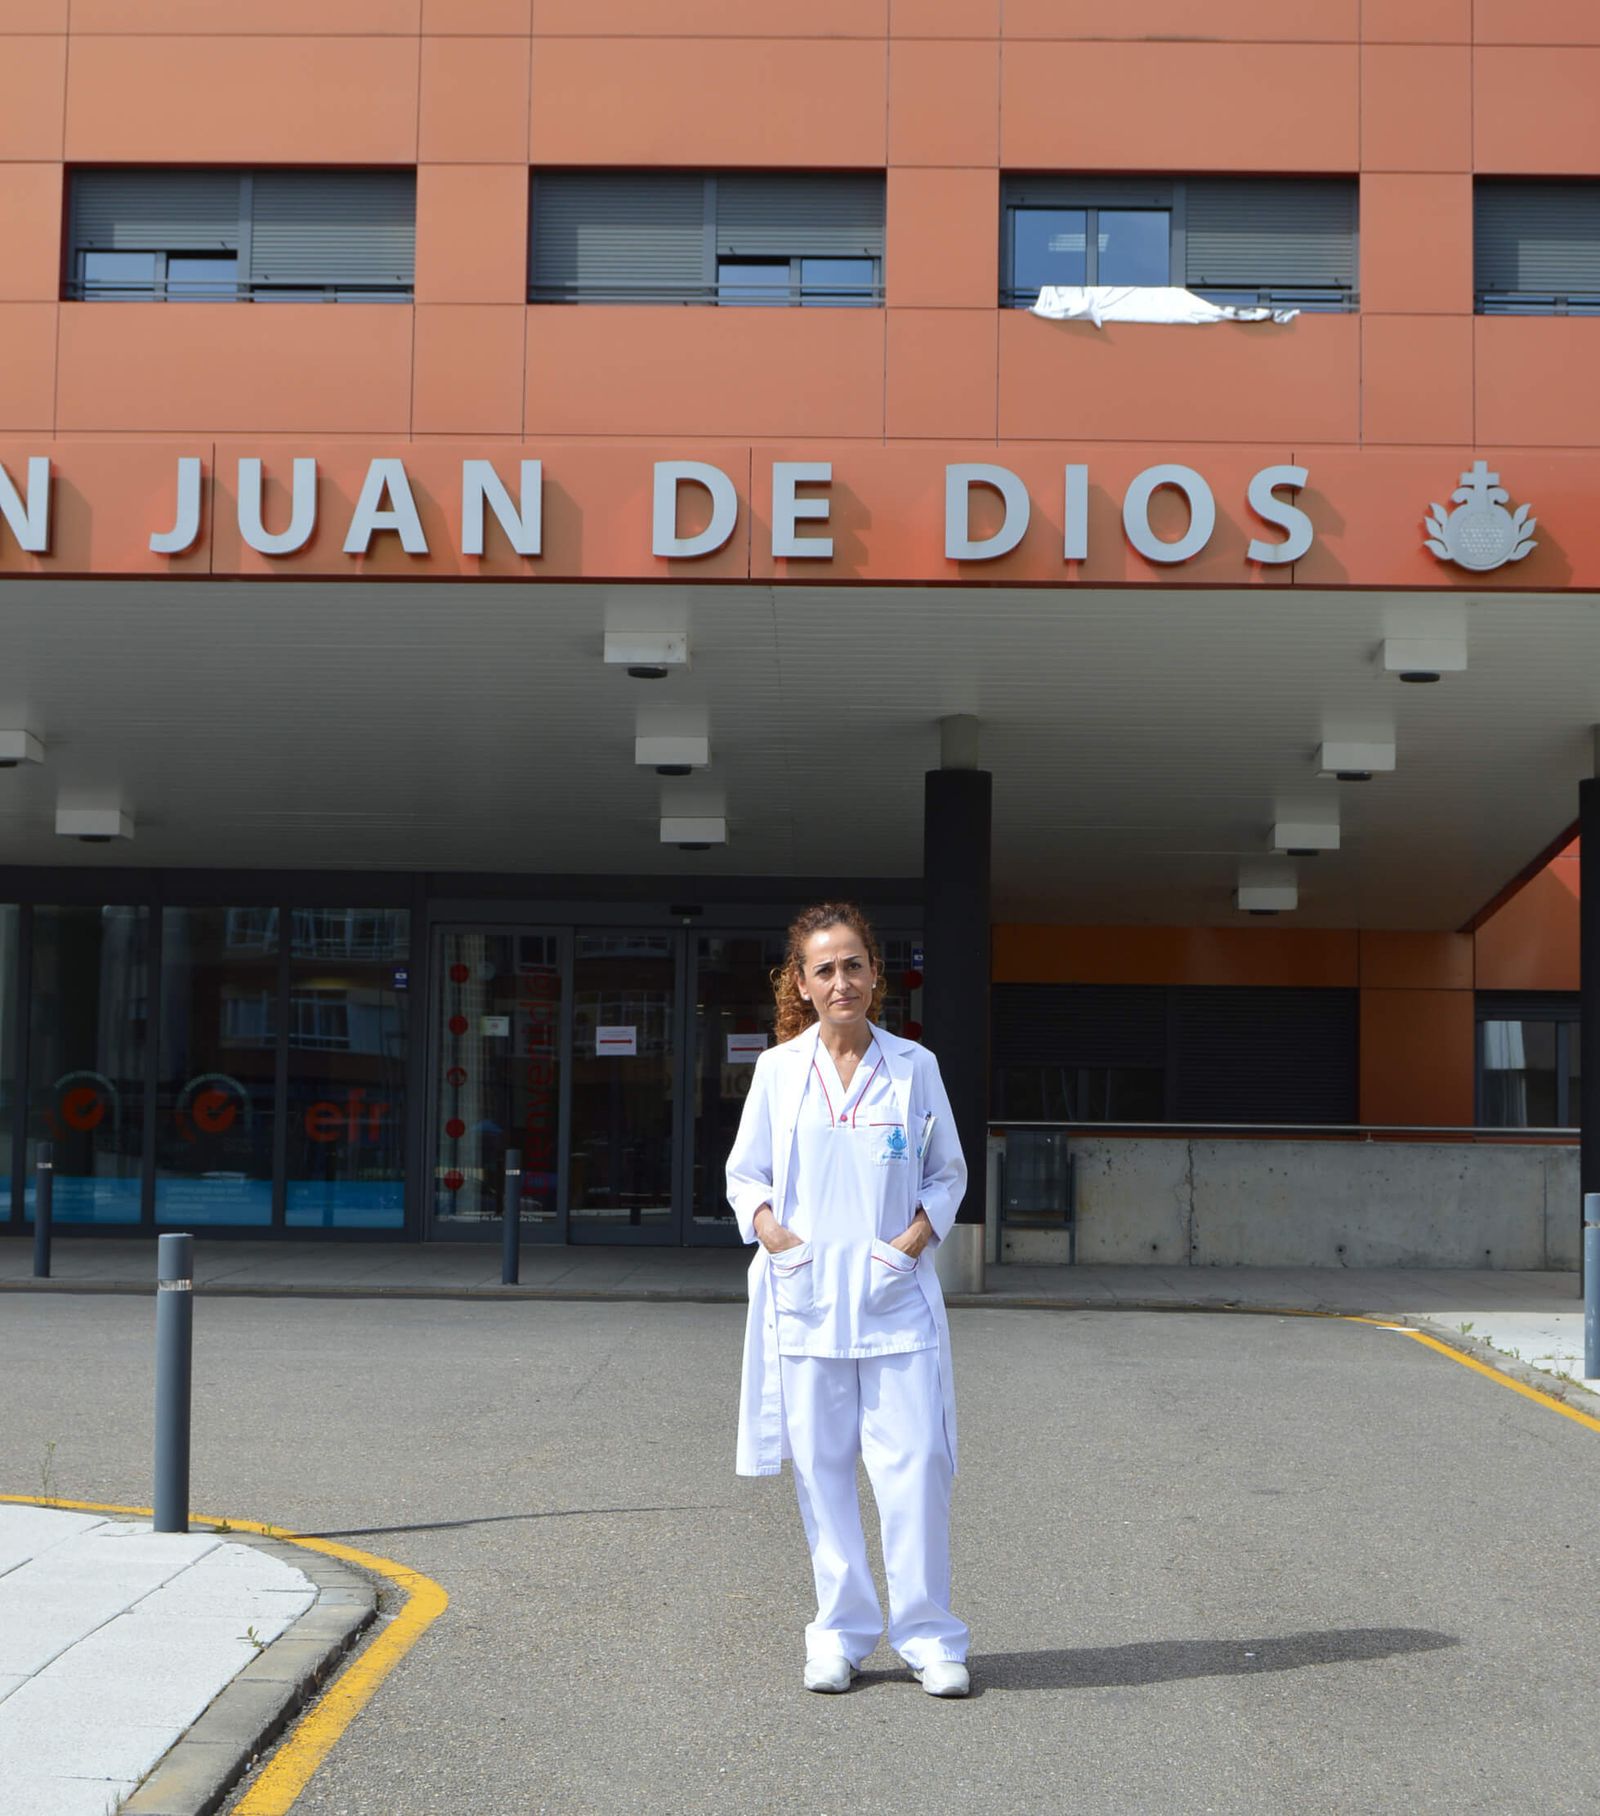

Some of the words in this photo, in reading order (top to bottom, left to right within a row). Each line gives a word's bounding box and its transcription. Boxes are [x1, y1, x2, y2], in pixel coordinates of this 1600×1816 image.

[149, 457, 540, 555] JUAN
[651, 461, 833, 557] DE
[945, 463, 1313, 565] DIOS
[304, 1087, 391, 1143] efr
